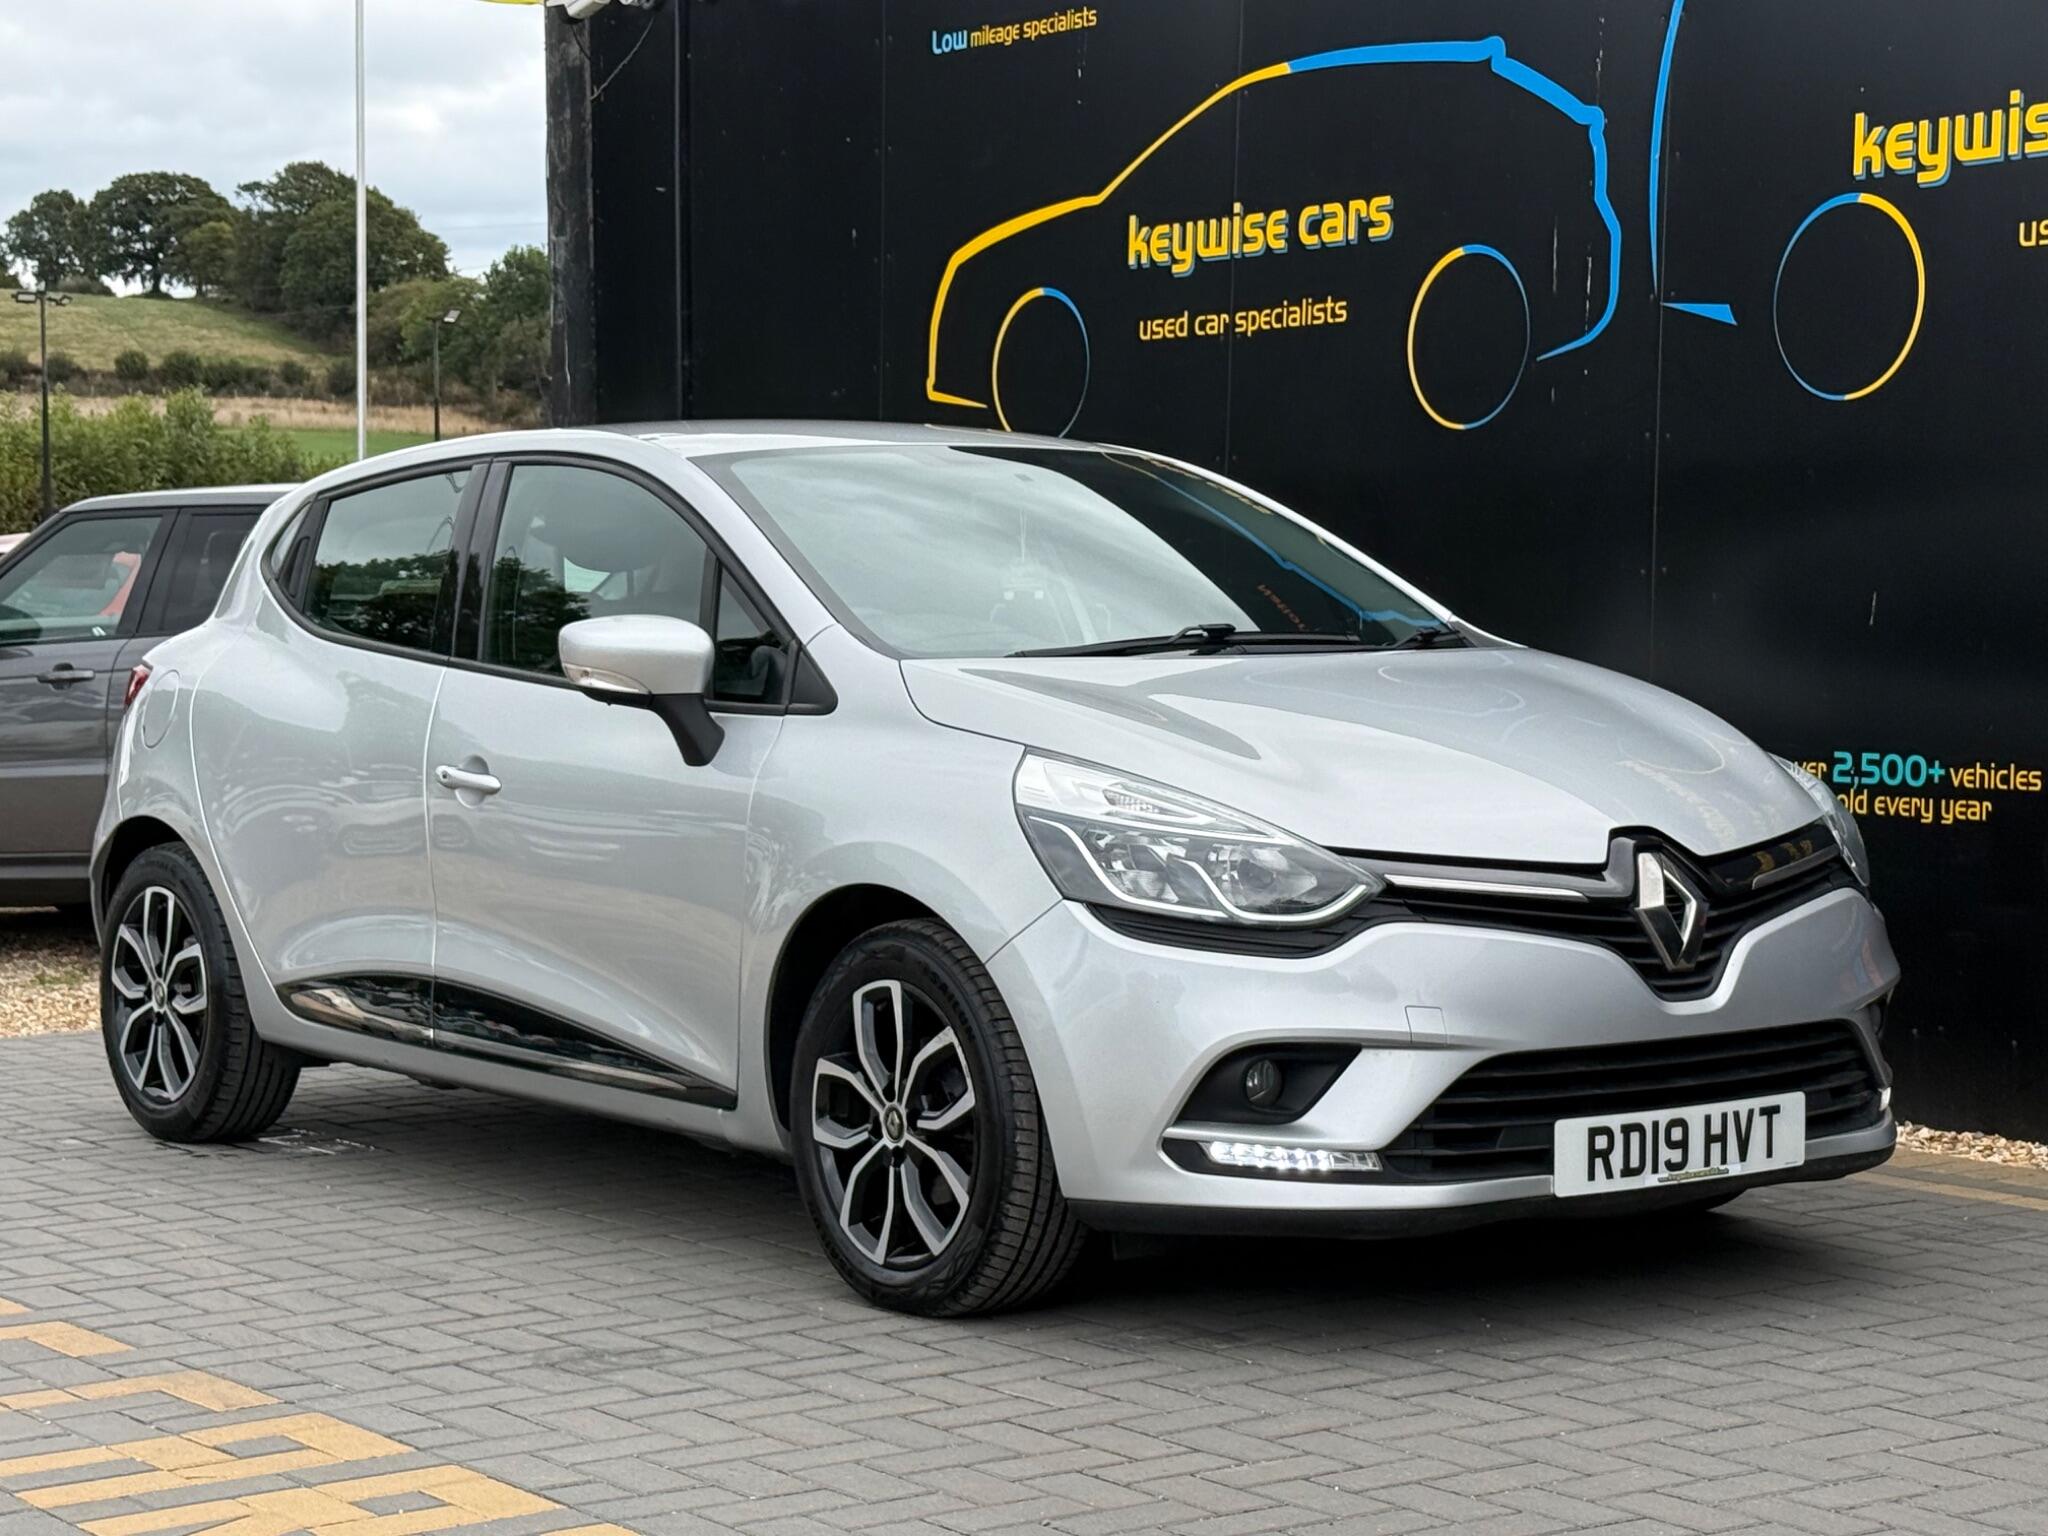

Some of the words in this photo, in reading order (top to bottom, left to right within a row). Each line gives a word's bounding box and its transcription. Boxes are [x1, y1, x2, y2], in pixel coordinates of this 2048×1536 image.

[932, 30, 967, 55] Low
[970, 24, 1020, 47] mileage
[1022, 6, 1098, 41] specialists
[1127, 202, 1289, 278] keywise
[1298, 195, 1395, 249] cars
[1139, 311, 1189, 341] used
[1194, 313, 1230, 336] car
[1234, 295, 1348, 338] specialists
[1832, 751, 1945, 790] 2,500+
[1950, 762, 2042, 791] vehicles
[1873, 795, 1934, 824] every
[1940, 798, 1993, 825] year
[1587, 1117, 1690, 1182] RD19
[1703, 1104, 1782, 1167] HVT
